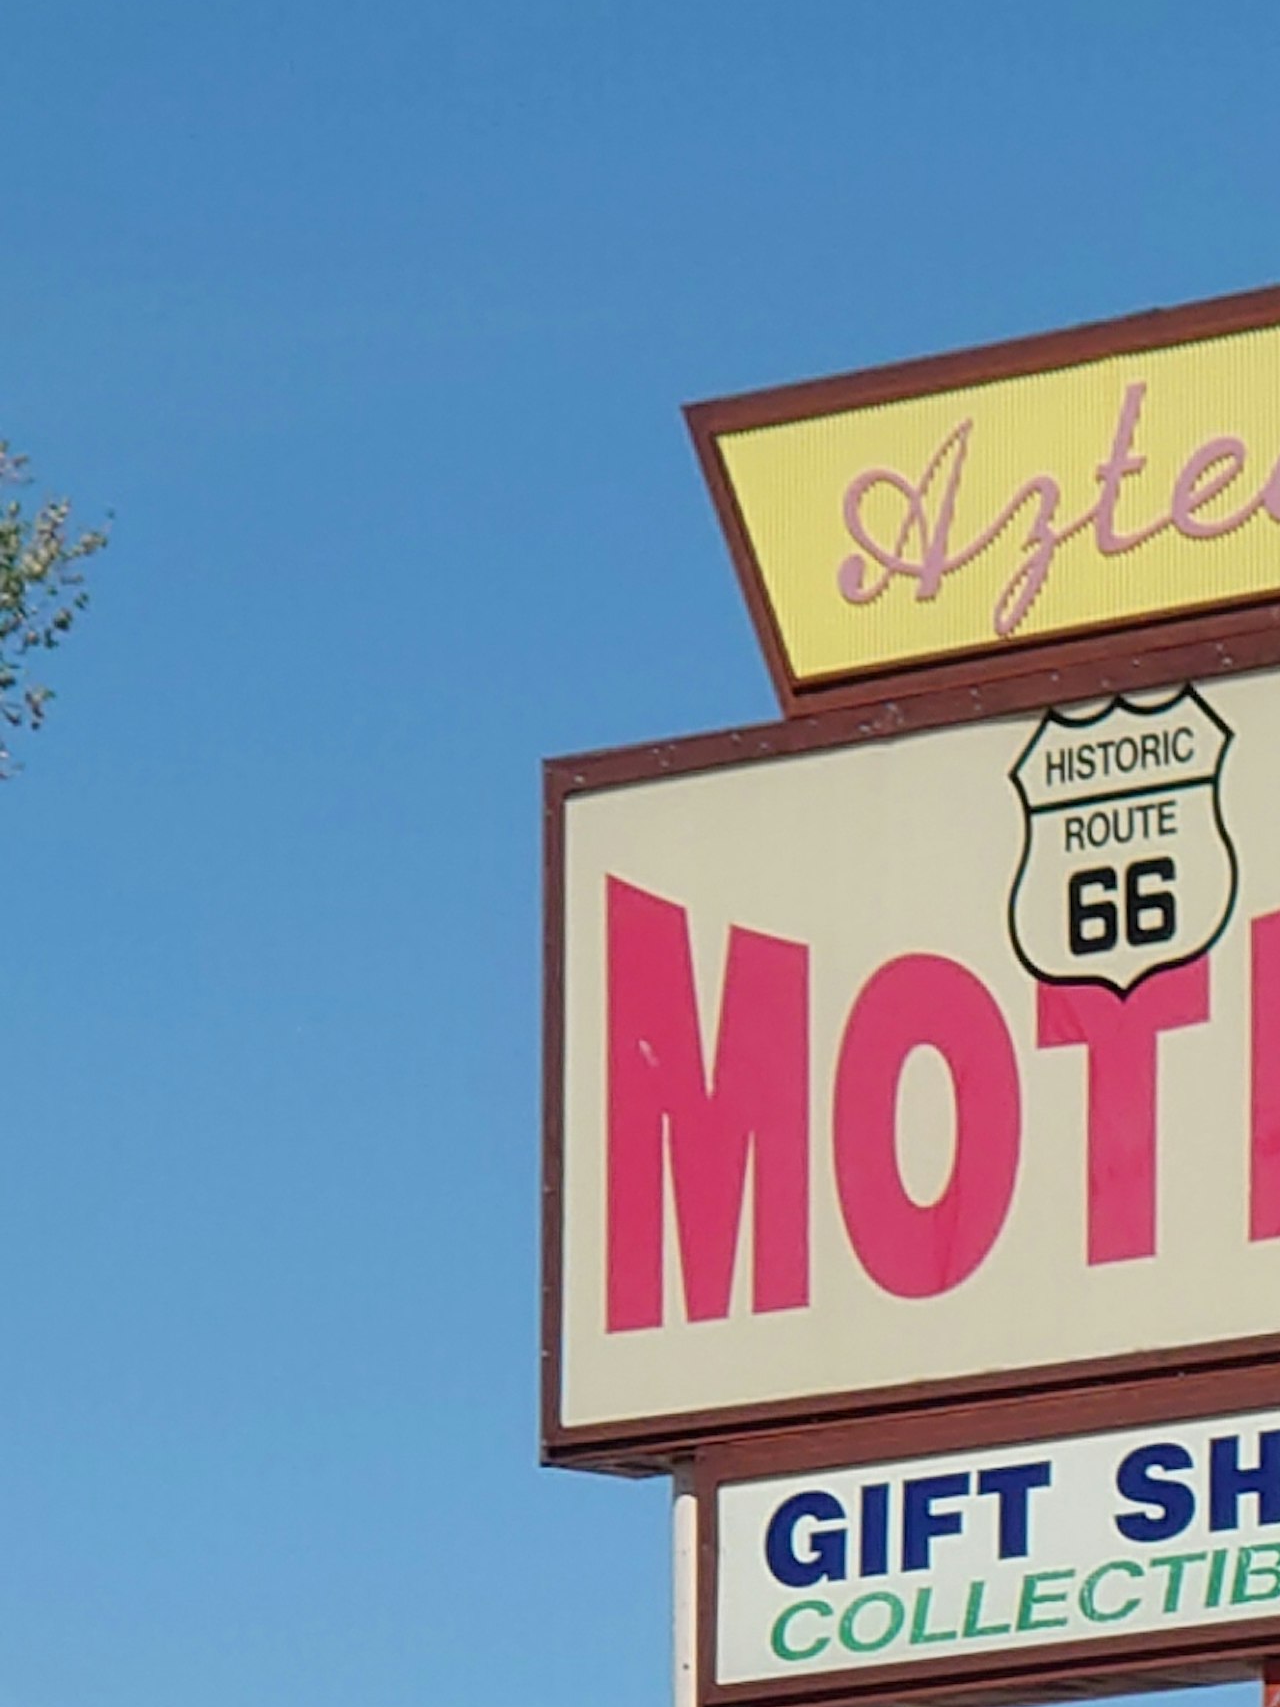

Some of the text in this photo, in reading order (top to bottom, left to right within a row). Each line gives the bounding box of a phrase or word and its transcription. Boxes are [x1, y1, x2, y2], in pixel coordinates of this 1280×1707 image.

[1046, 726, 1195, 787] HISTORIC
[1064, 799, 1178, 854] ROUTE
[1067, 855, 1178, 957] 66
[766, 1463, 1050, 1587] GIFT
